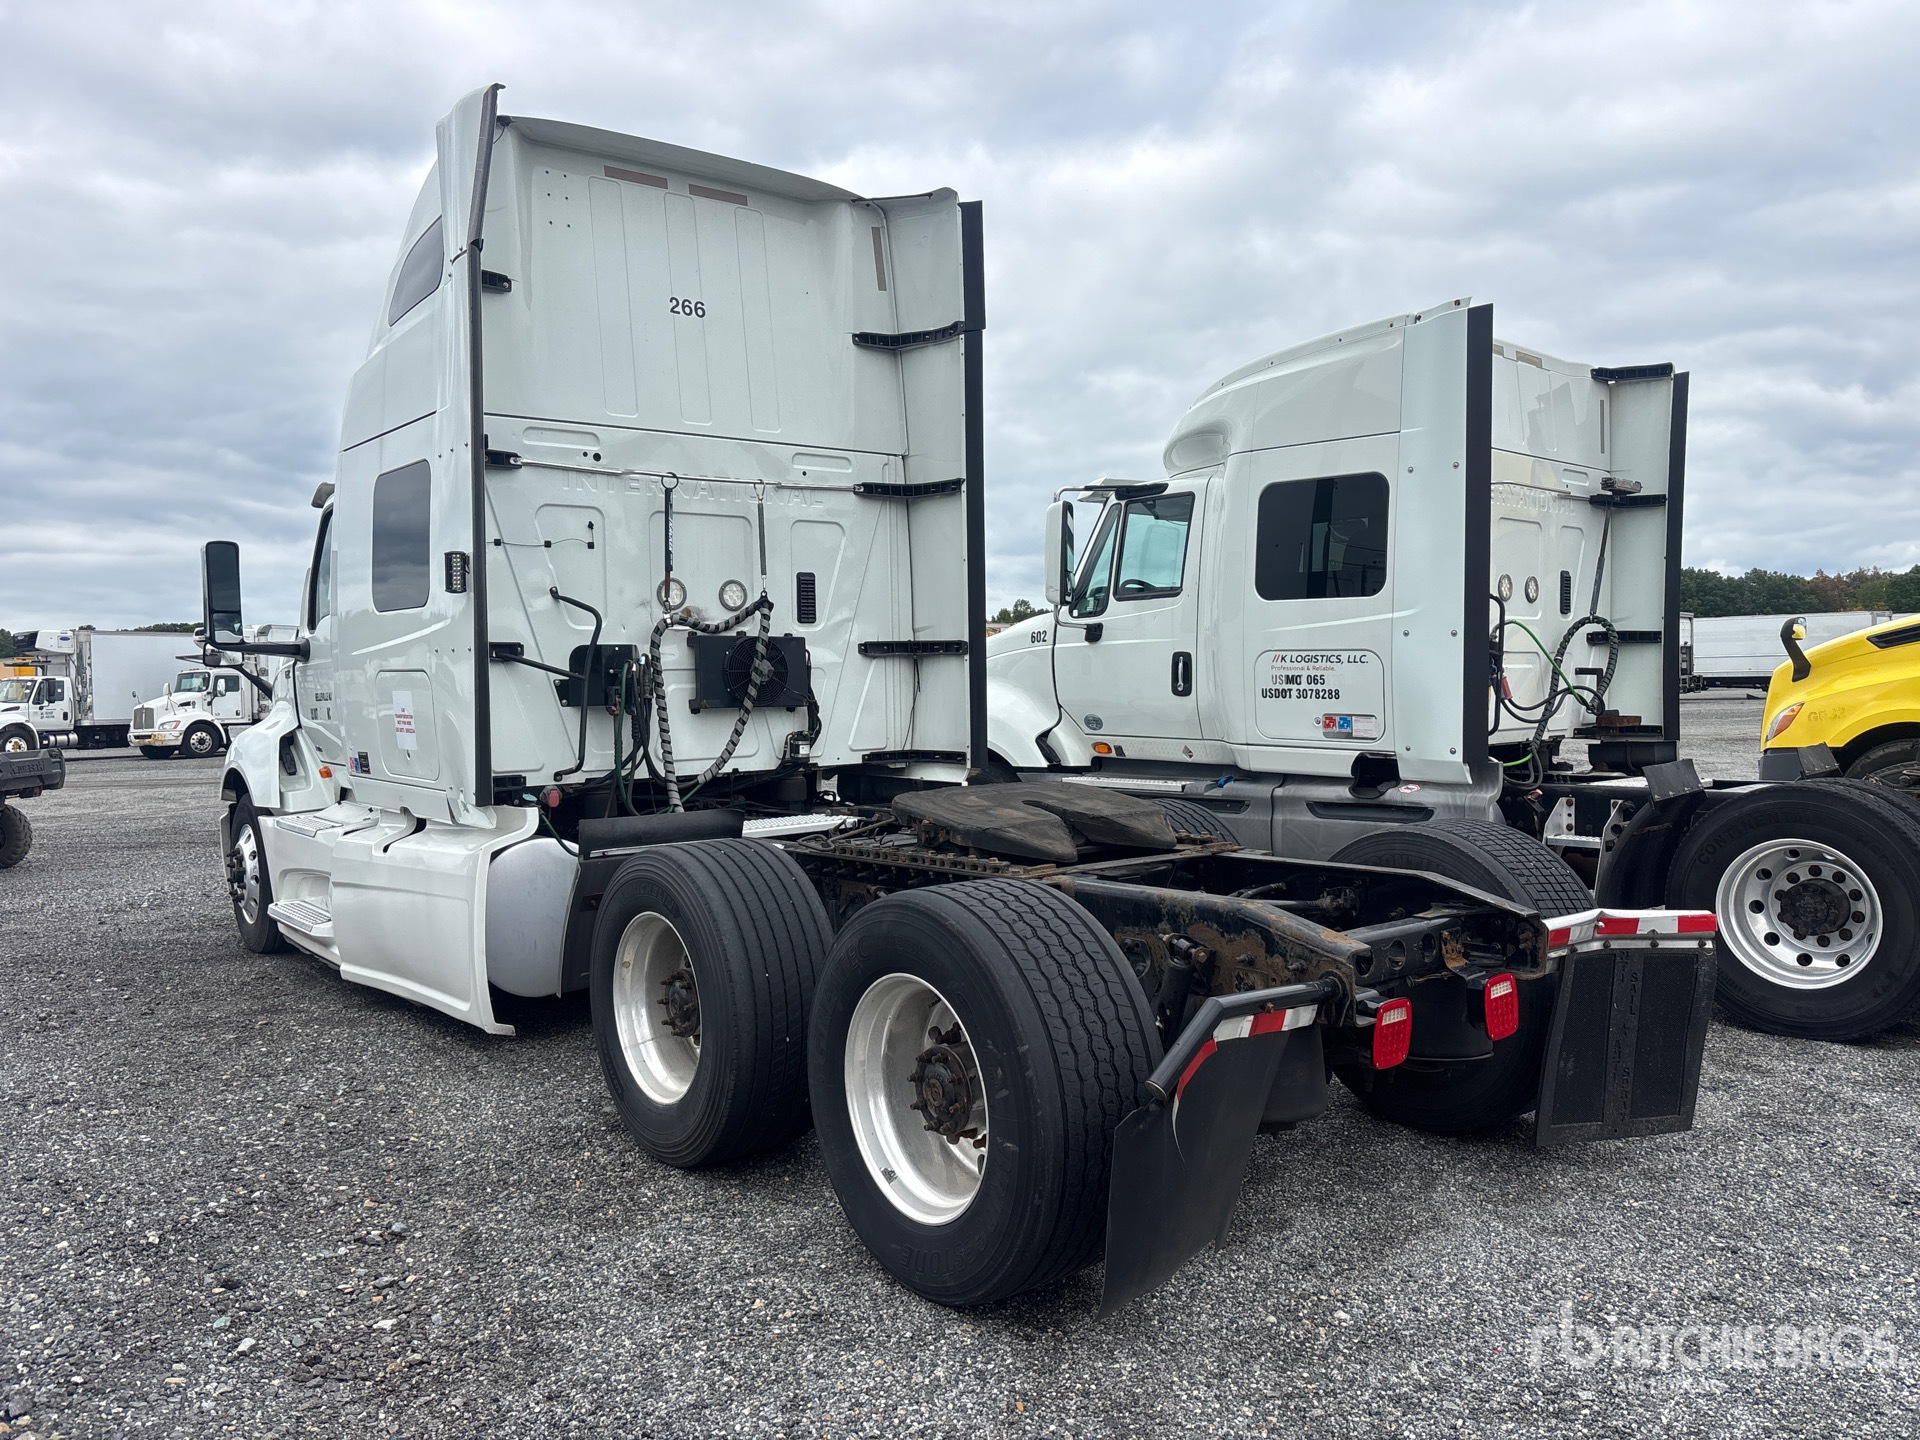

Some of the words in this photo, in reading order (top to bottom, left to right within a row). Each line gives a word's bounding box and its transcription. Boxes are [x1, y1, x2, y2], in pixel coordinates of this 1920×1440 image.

[669, 296, 706, 318] 266
[1030, 630, 1047, 643] 602
[1290, 655, 1344, 665] LOGISTICS,
[1347, 655, 1369, 663] LLC.
[1261, 688, 1293, 699] USDOT
[1295, 689, 1340, 700] 3078288
[1697, 810, 1815, 865] CONTINENTAL
